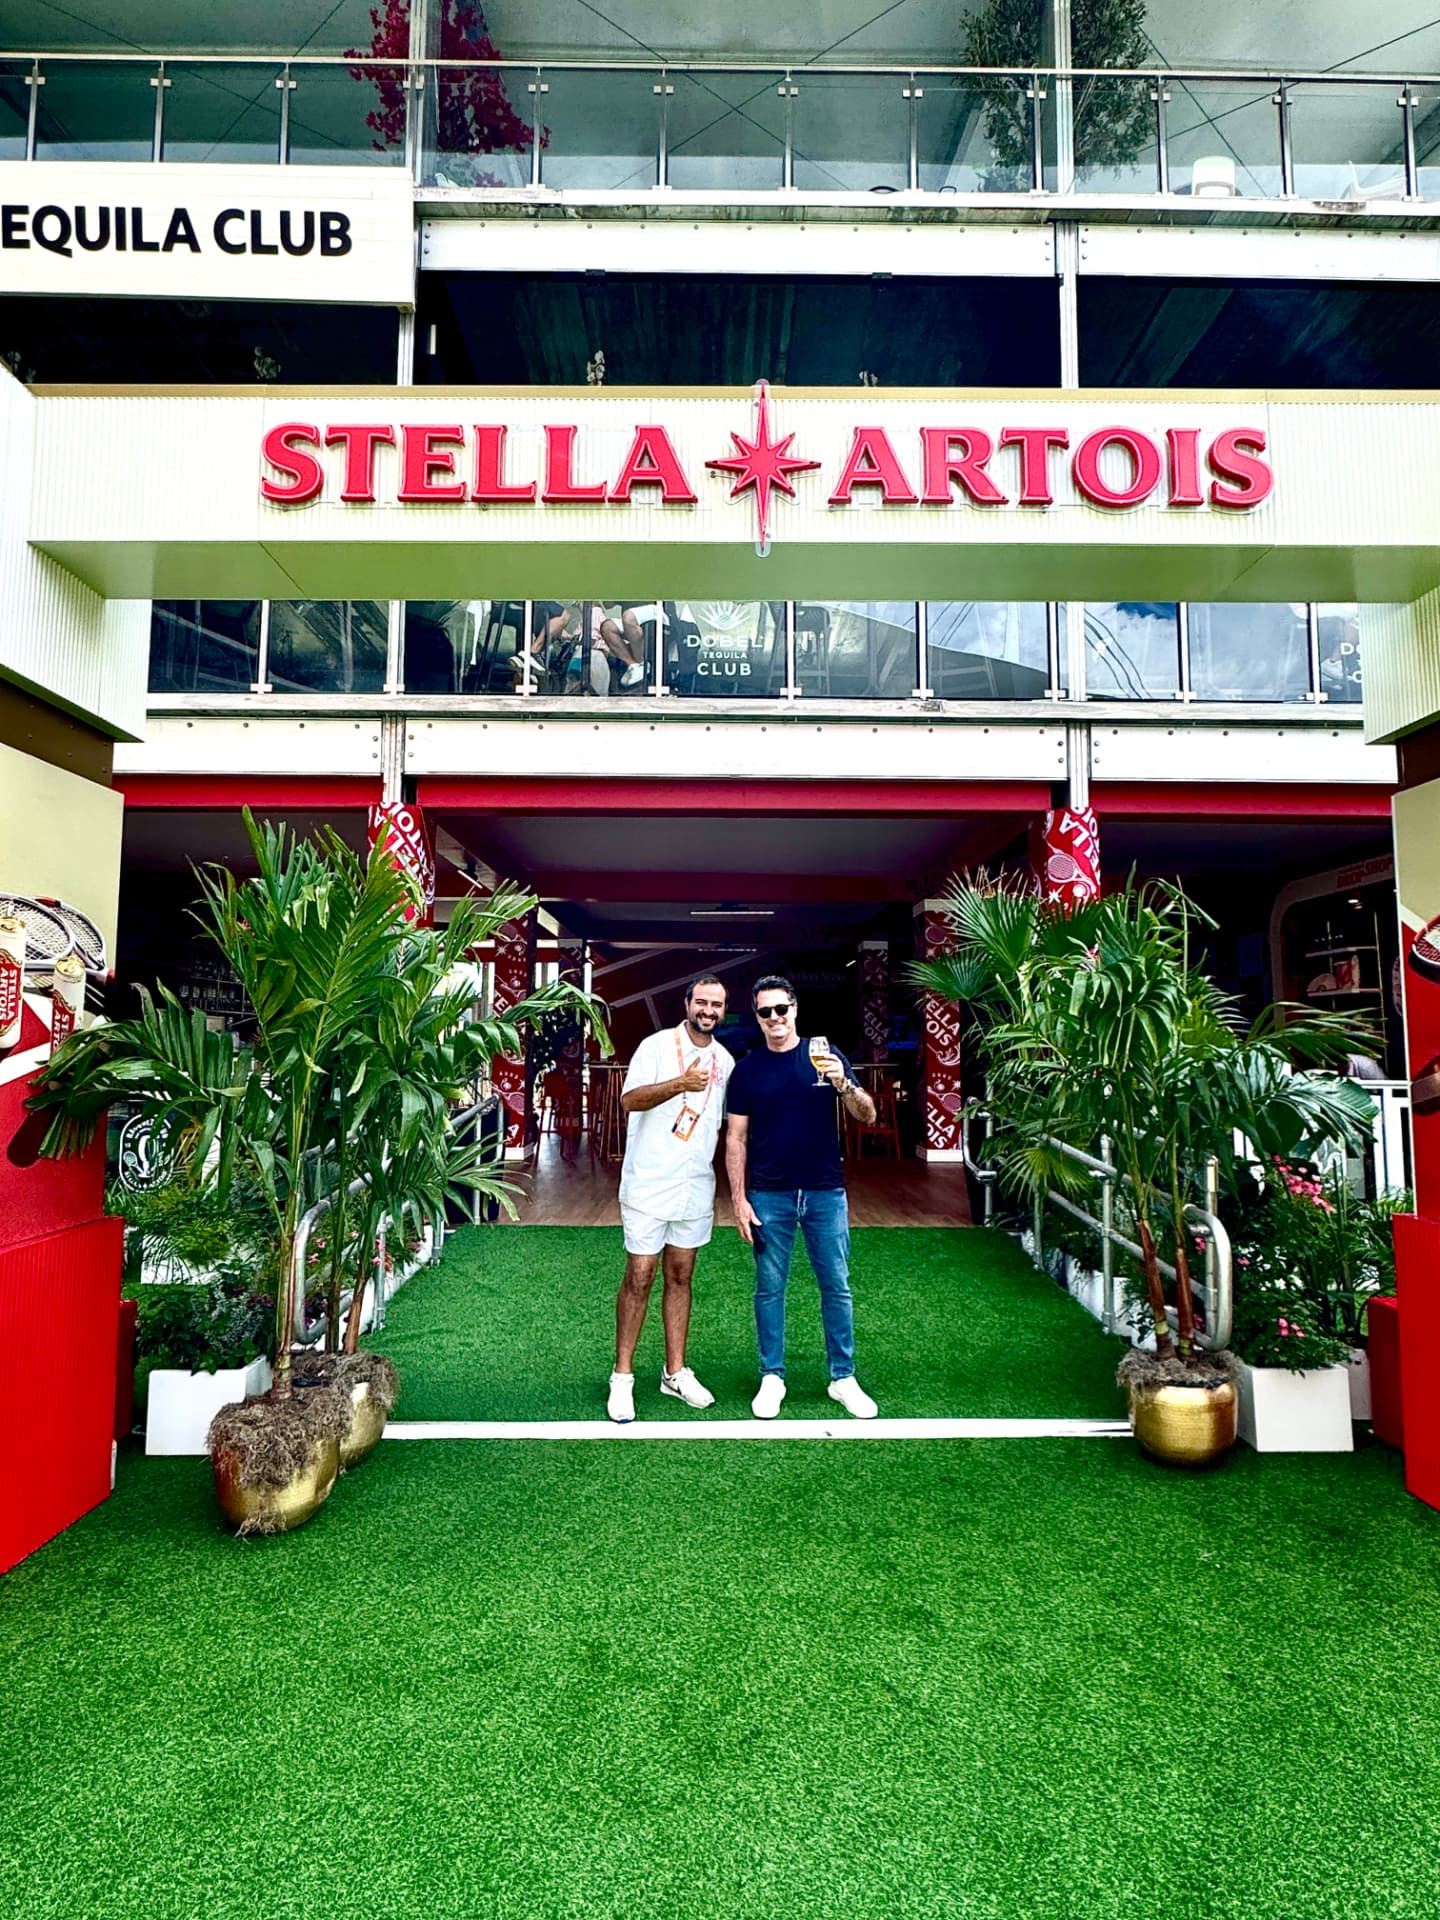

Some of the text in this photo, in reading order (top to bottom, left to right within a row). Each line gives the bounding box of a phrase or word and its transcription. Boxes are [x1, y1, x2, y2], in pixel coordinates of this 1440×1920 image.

[2, 204, 353, 258] EQUILA CLUB
[260, 421, 1275, 508] STELLA ARTOIS
[686, 634, 764, 648] DOBEL
[703, 651, 748, 659] TEQUILA
[696, 662, 752, 676] CLUB
